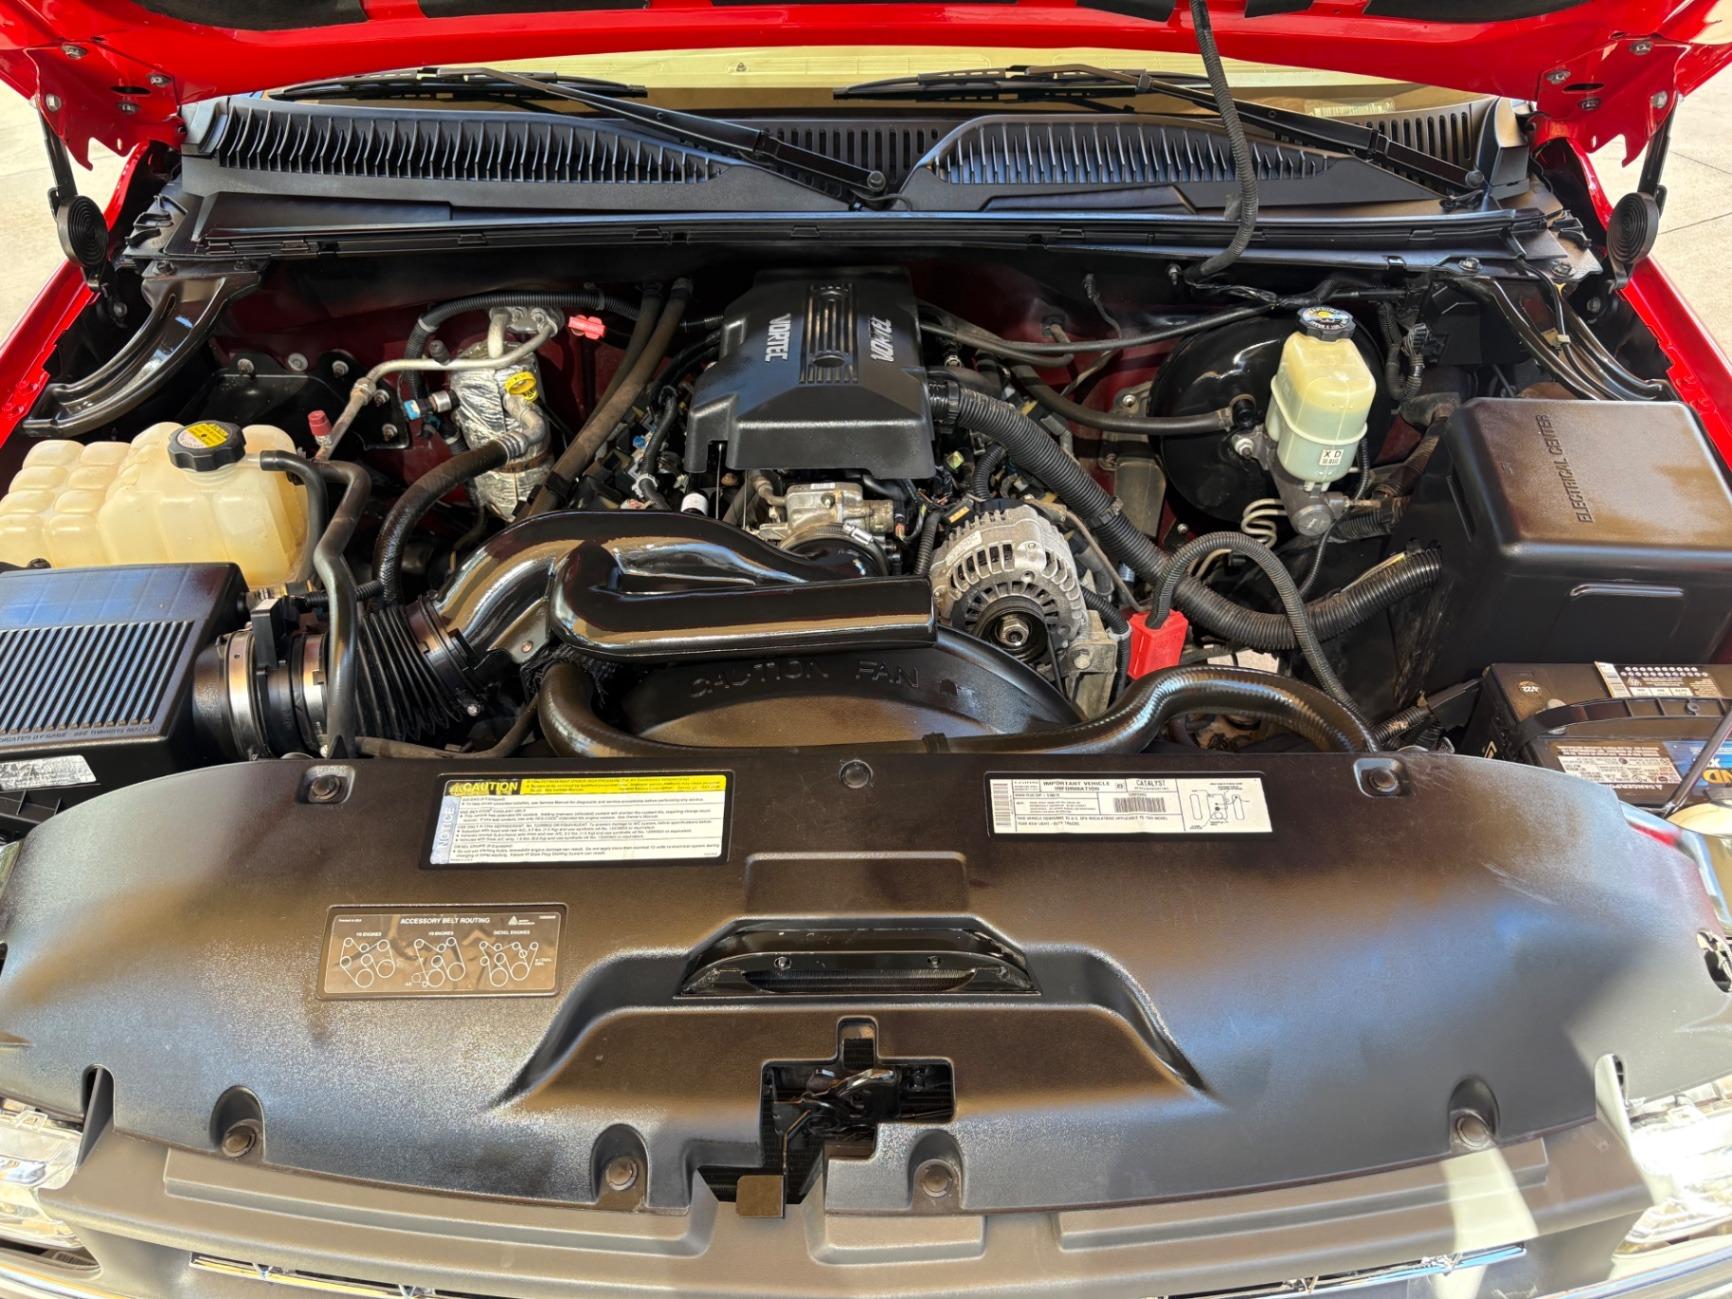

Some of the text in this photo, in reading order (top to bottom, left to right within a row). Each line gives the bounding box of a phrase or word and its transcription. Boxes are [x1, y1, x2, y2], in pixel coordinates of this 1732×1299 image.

[765, 313, 791, 362] VORTEC
[1536, 414, 1593, 523] ELECTRICAL CENTER
[690, 660, 919, 699] CAUTION FAN
[464, 781, 518, 792] CAUTION
[400, 917, 441, 925] ACCESSORY
